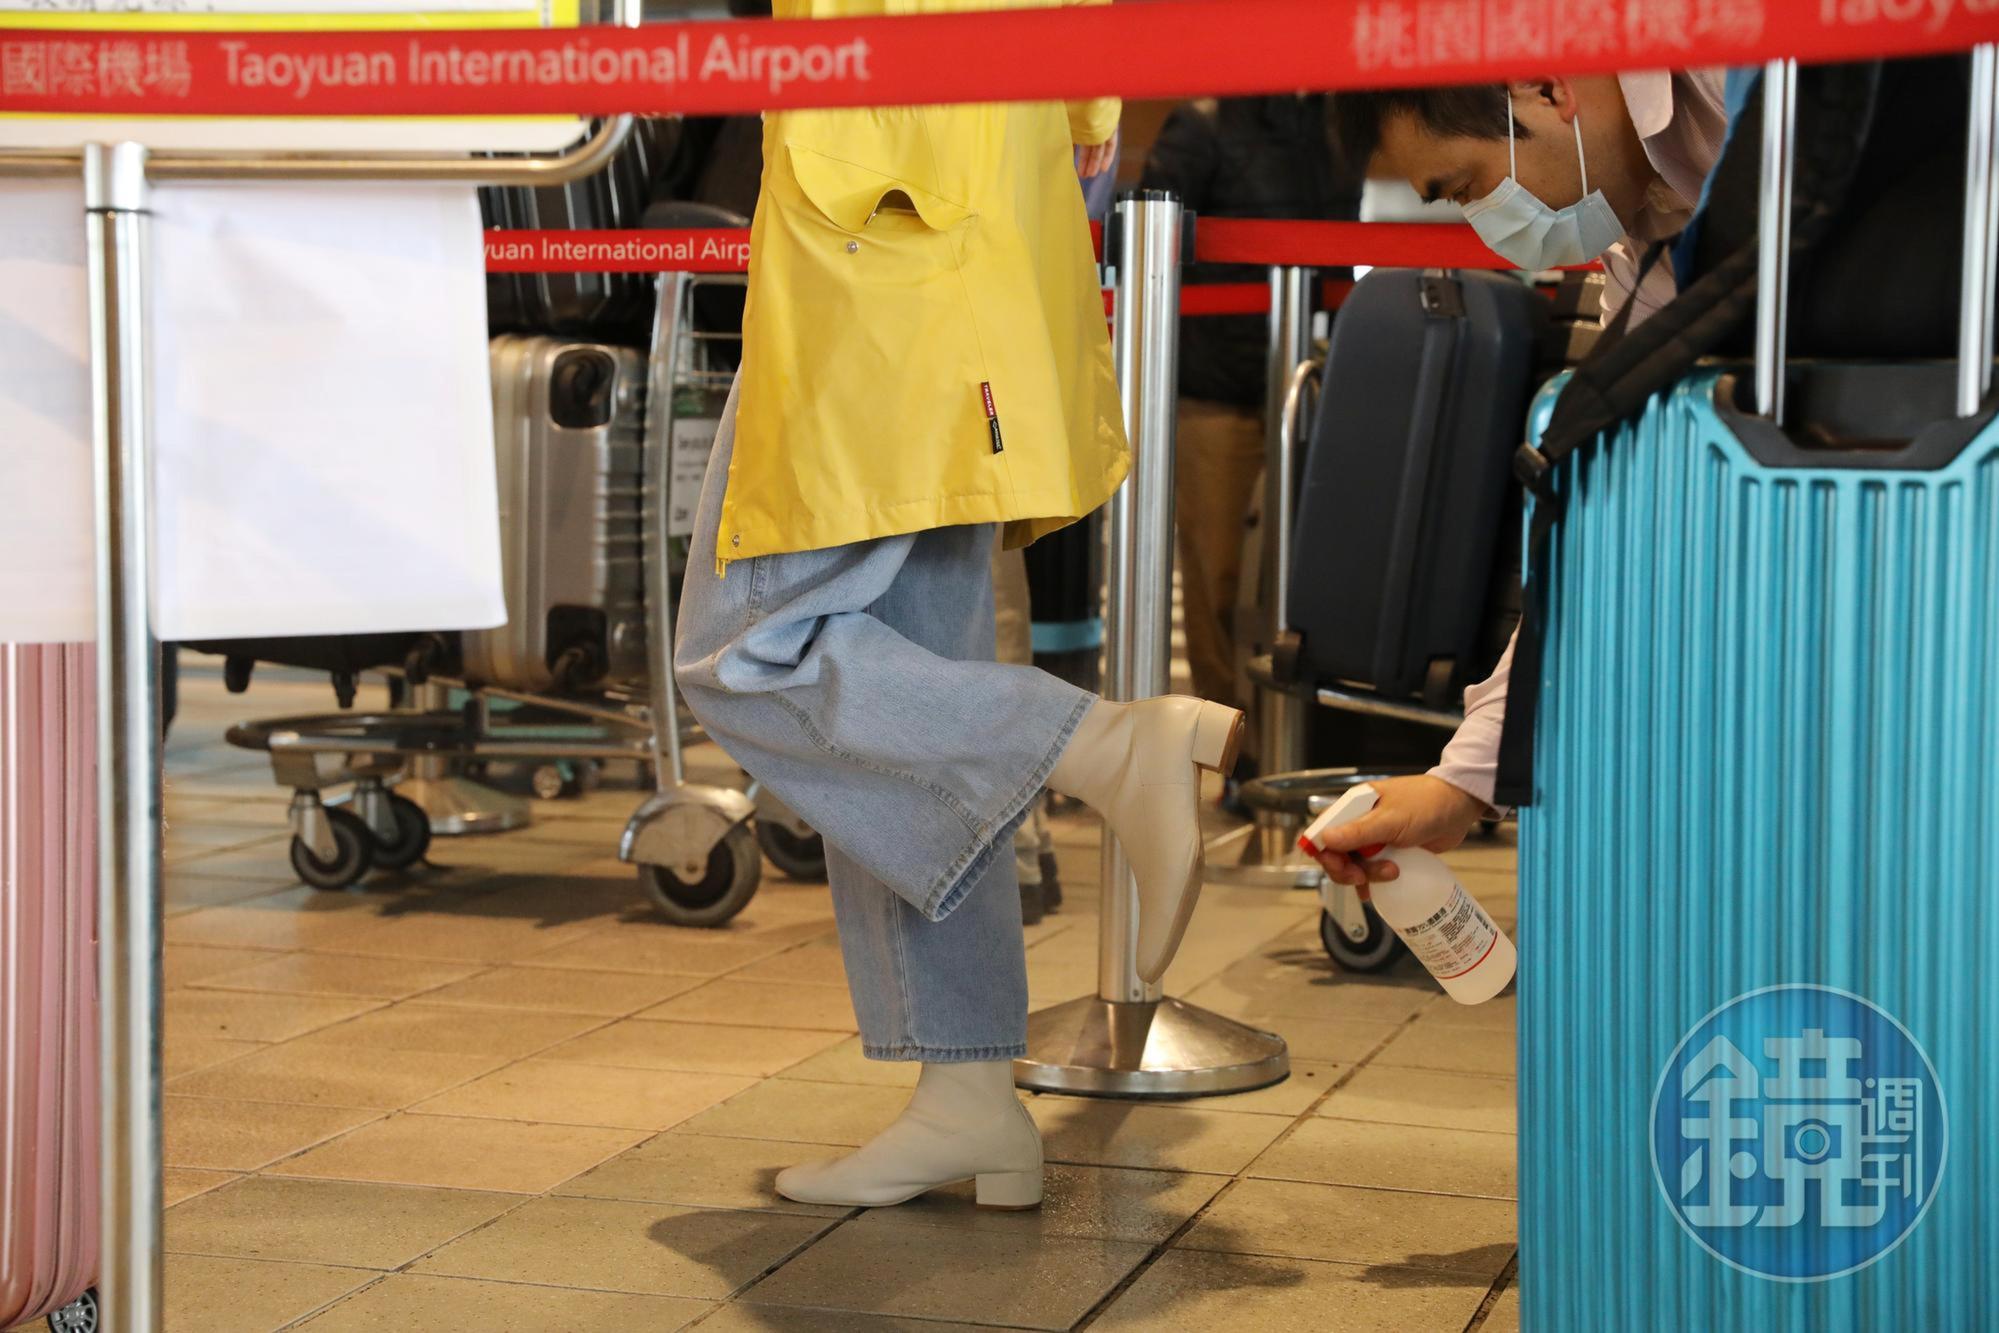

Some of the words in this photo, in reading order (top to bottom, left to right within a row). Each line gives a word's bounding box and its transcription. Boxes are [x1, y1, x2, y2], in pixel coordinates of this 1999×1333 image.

[2, 40, 193, 97] 國際機場
[219, 40, 396, 99] Taoyuan
[408, 31, 690, 86] International
[699, 33, 871, 95] Airport
[542, 237, 694, 260] International
[700, 237, 751, 267] Airp
